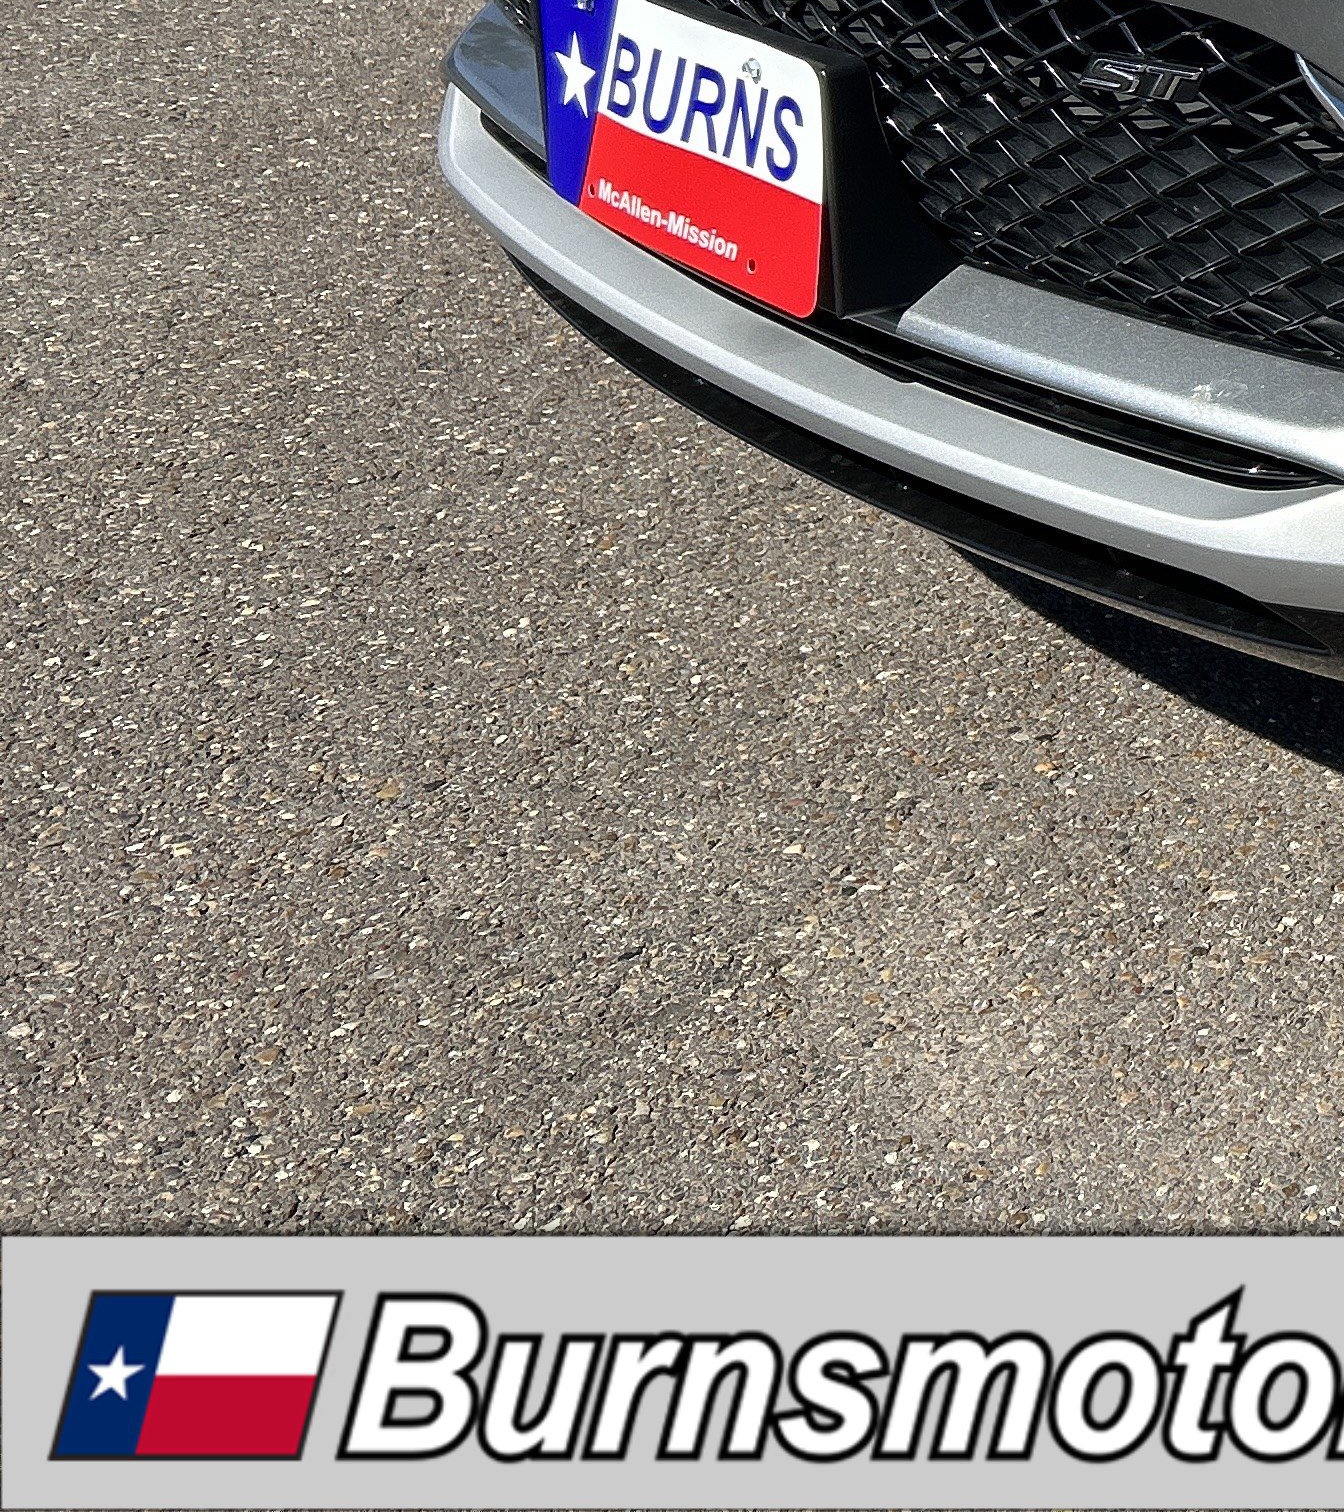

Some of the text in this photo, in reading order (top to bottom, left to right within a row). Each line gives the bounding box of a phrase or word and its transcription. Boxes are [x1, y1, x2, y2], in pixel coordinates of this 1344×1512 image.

[606, 33, 804, 182] BURNS
[1078, 58, 1202, 100] ST
[597, 177, 738, 262] McAllen-Mission
